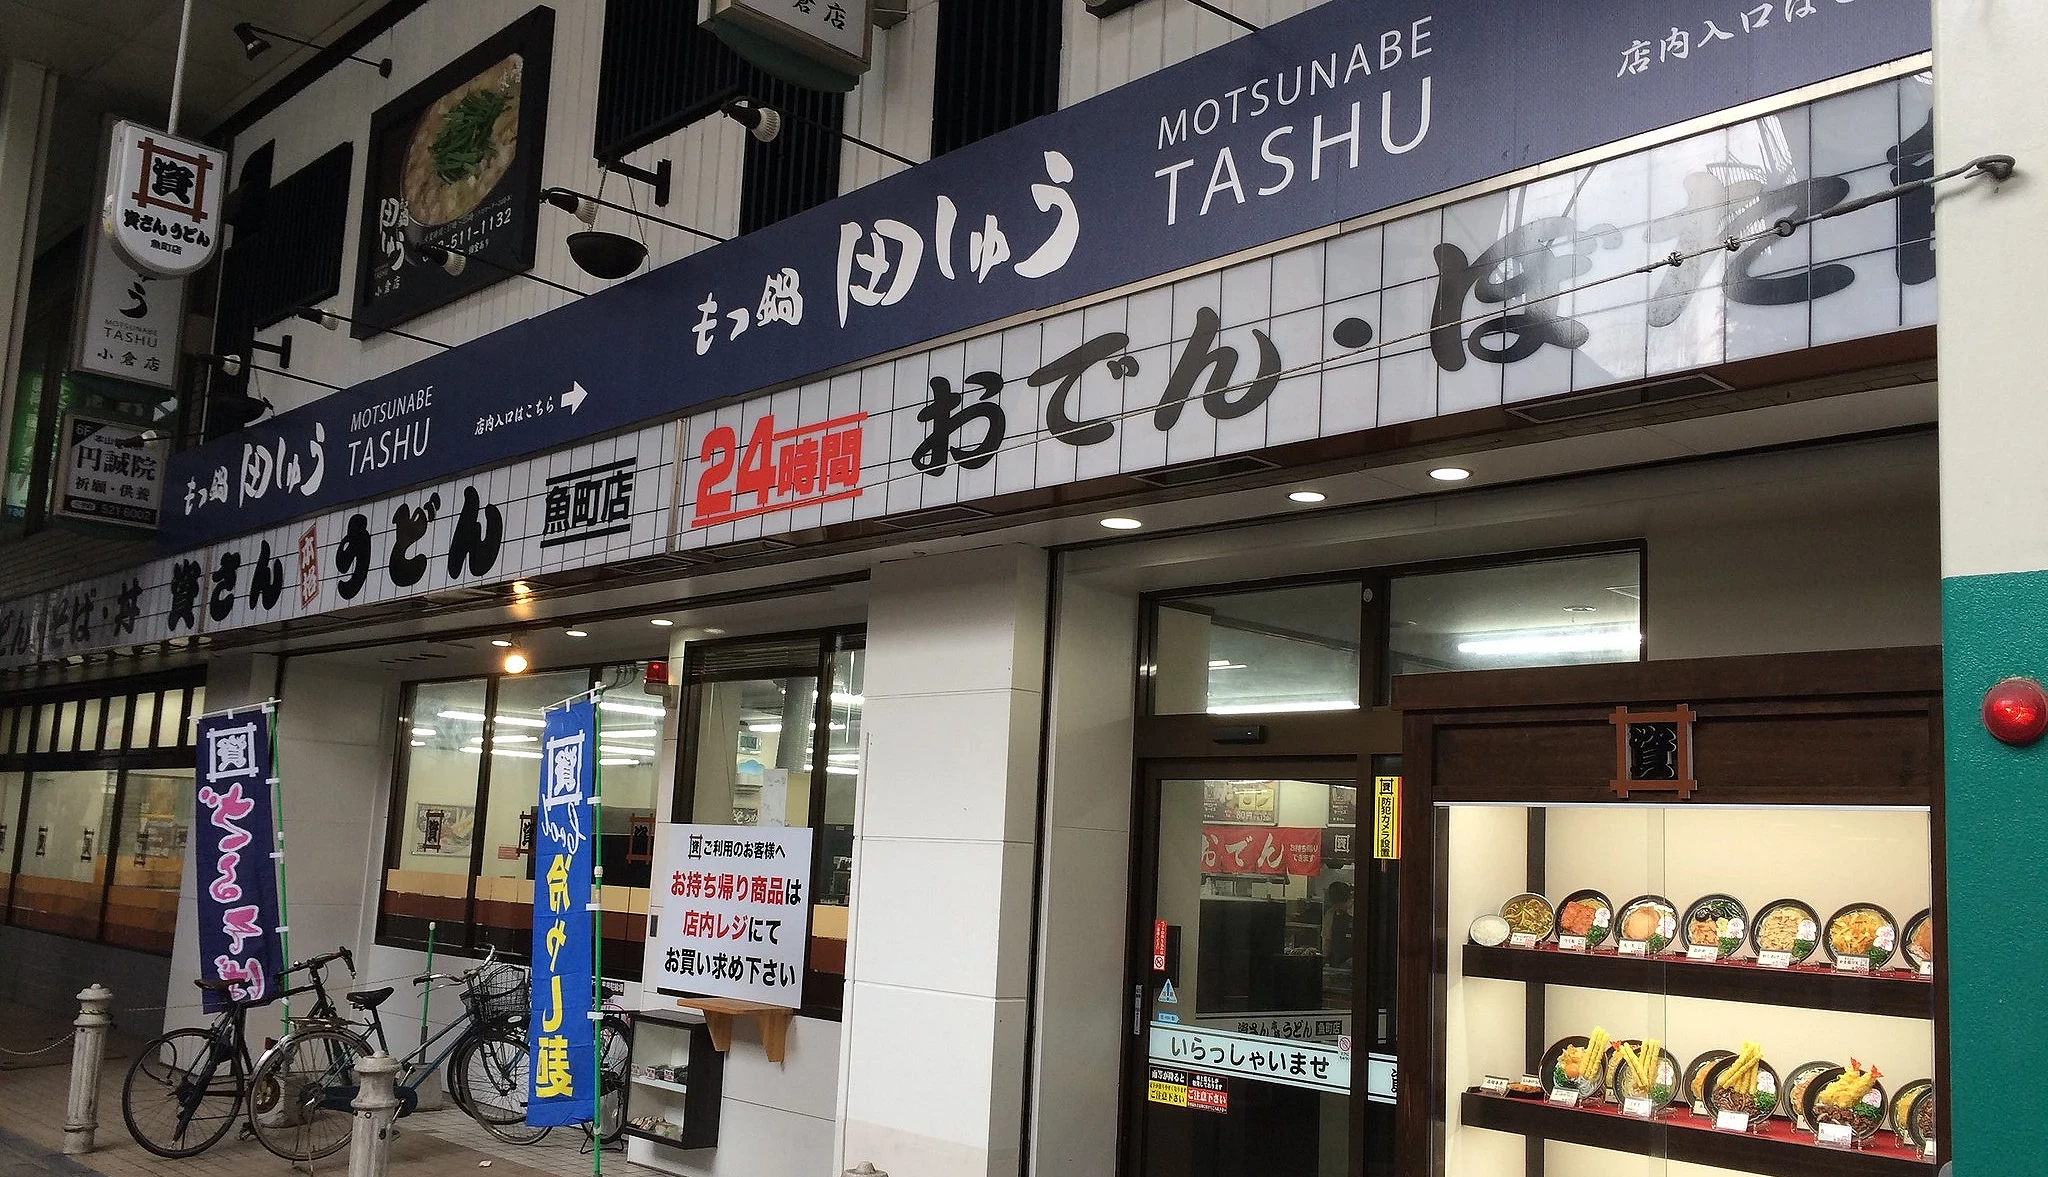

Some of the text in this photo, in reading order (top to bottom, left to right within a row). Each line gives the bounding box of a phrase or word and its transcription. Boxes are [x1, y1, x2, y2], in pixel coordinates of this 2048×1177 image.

[1617, 0, 1852, 77] 店内入口は
[1157, 15, 1434, 150] MOTSUNABE
[1153, 75, 1434, 228] TASHU
[152, 157, 195, 205] 資
[124, 209, 210, 247] 資さん うどん
[150, 239, 182, 255] 魚町店
[691, 150, 1080, 356] もつ鍋 田しゅう
[97, 348, 161, 372] 小倉店
[104, 326, 158, 348] TASHU
[350, 385, 434, 432] MOTSUNABE
[474, 396, 556, 436] 店内入口はこちら
[77, 444, 158, 481] 円誠院
[239, 422, 325, 508] 田しゅう
[349, 417, 431, 476] TASHU
[698, 414, 863, 518] 24時間
[543, 470, 634, 536] 魚町店
[168, 539, 283, 632] 資さん
[336, 486, 503, 600] うどん
[704, 840, 786, 860] ご利用のお客様へ
[1381, 797, 1392, 858] 防犯カメラ設置
[671, 870, 802, 906] お持ち帰り商品は
[683, 910, 782, 945] 店内レジにて
[665, 947, 796, 988] お買い求め下さい
[1172, 1037, 1329, 1080] いらっしゃいませ
